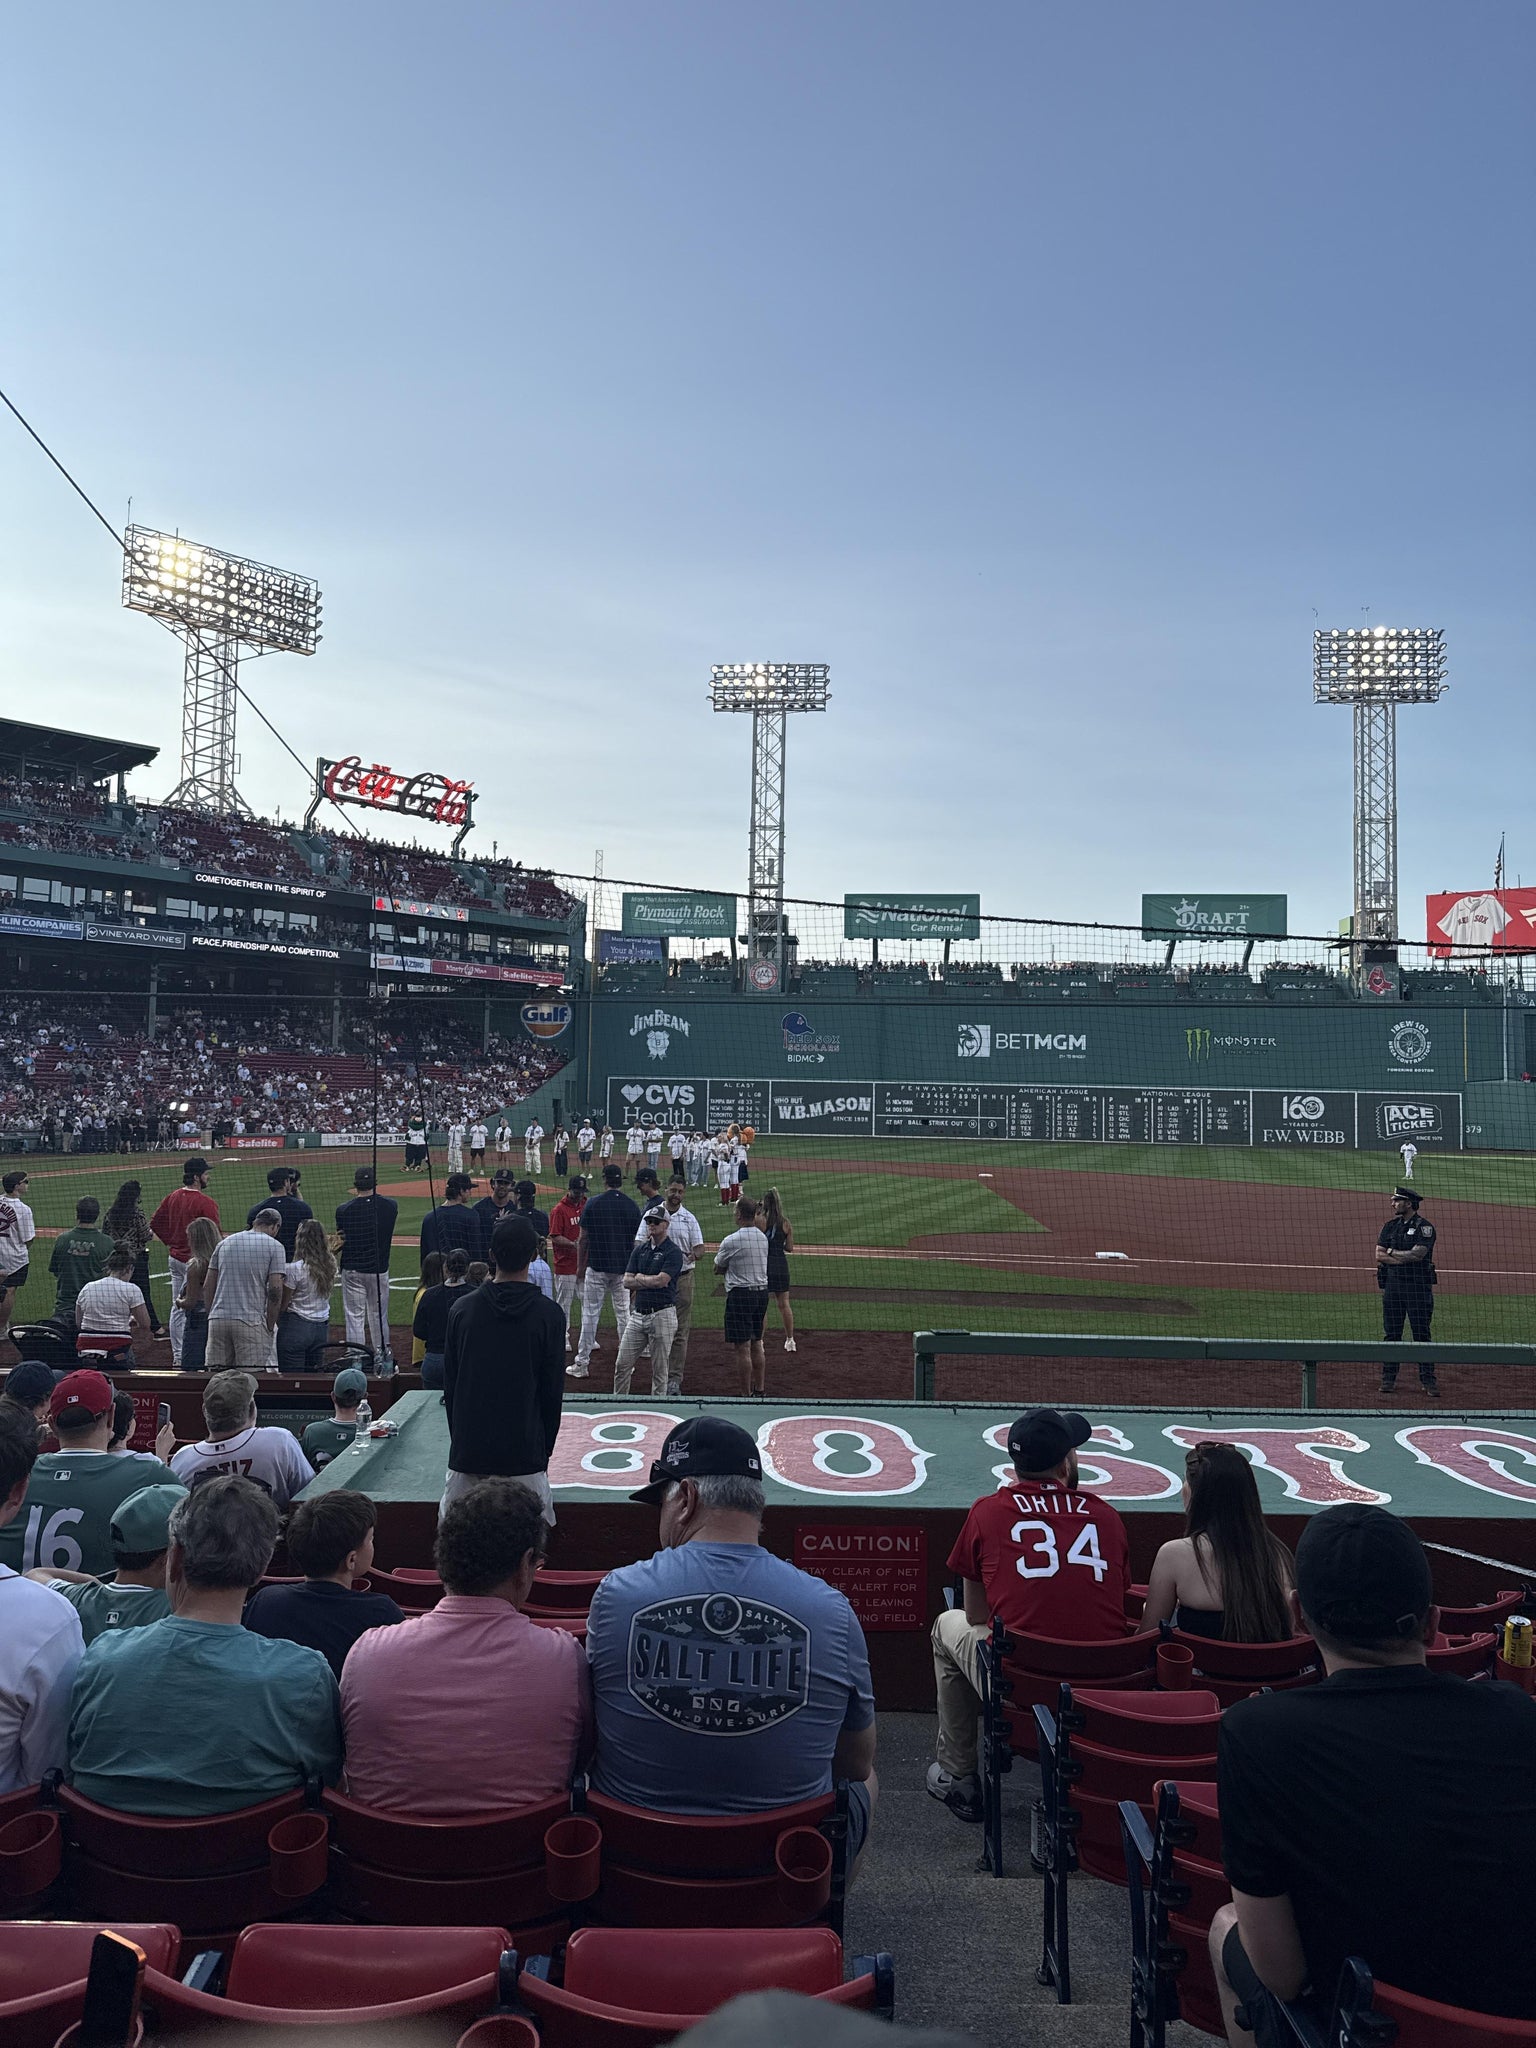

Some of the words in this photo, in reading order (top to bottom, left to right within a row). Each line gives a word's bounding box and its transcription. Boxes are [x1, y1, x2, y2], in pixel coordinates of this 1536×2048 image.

[195, 874, 263, 890] COMETOGETHER
[274, 884, 289, 893] THE
[290, 886, 314, 896] SPIRIT
[635, 905, 691, 919] Plymouth
[694, 905, 725, 918] Rock
[881, 904, 968, 922] National
[1176, 912, 1250, 927] DRAFT
[1474, 915, 1488, 924] SOX
[22, 919, 81, 931] COMPANIES
[930, 924, 962, 932] Rental
[1186, 924, 1247, 937] KINGS
[99, 929, 150, 940] VINEYARD
[152, 935, 182, 944] VINES
[192, 937, 269, 952] PEACE,FRIENDSHIP
[270, 945, 286, 953] AND
[288, 947, 340, 958] COMPETITION.
[504, 971, 533, 980] Safelite
[523, 1007, 568, 1022] Gulf
[629, 1014, 654, 1036] JIM
[654, 1009, 690, 1037] BEAM
[1390, 1020, 1413, 1034] IBEW
[1413, 1022, 1430, 1034] 103
[788, 1035, 812, 1044] RED
[815, 1035, 840, 1044] SOX
[995, 1033, 1086, 1050] BETMGM
[1214, 1036, 1277, 1047] MONSTER
[787, 1044, 840, 1052] SCHOLARS
[787, 1054, 815, 1063] BIDMC
[646, 1084, 695, 1105] CVS
[778, 1097, 871, 1120] W.B.MASON
[1283, 1096, 1324, 1120] 160
[1389, 1105, 1434, 1121] ACE
[623, 1106, 695, 1126] Health
[1390, 1119, 1435, 1132] TICKET
[1466, 1126, 1482, 1134] 379
[237, 1139, 278, 1148] Safelite
[1263, 1130, 1291, 1142] F.W.
[1297, 1131, 1345, 1144] WEBB
[207, 1459, 252, 1474] TIZ
[1013, 1492, 1091, 1515] ORTIZ
[22, 1505, 84, 1572] 16
[802, 1534, 919, 1552] CAUTION!
[1010, 1520, 1109, 1583] 34
[832, 1568, 871, 1576] CLEAR
[876, 1568, 892, 1576] OF
[852, 1583, 888, 1592] ALERT
[894, 1583, 917, 1592] FOR
[884, 1614, 916, 1622] FIELD
[634, 1633, 716, 1682] SALT
[728, 1646, 803, 1694] LIFE
